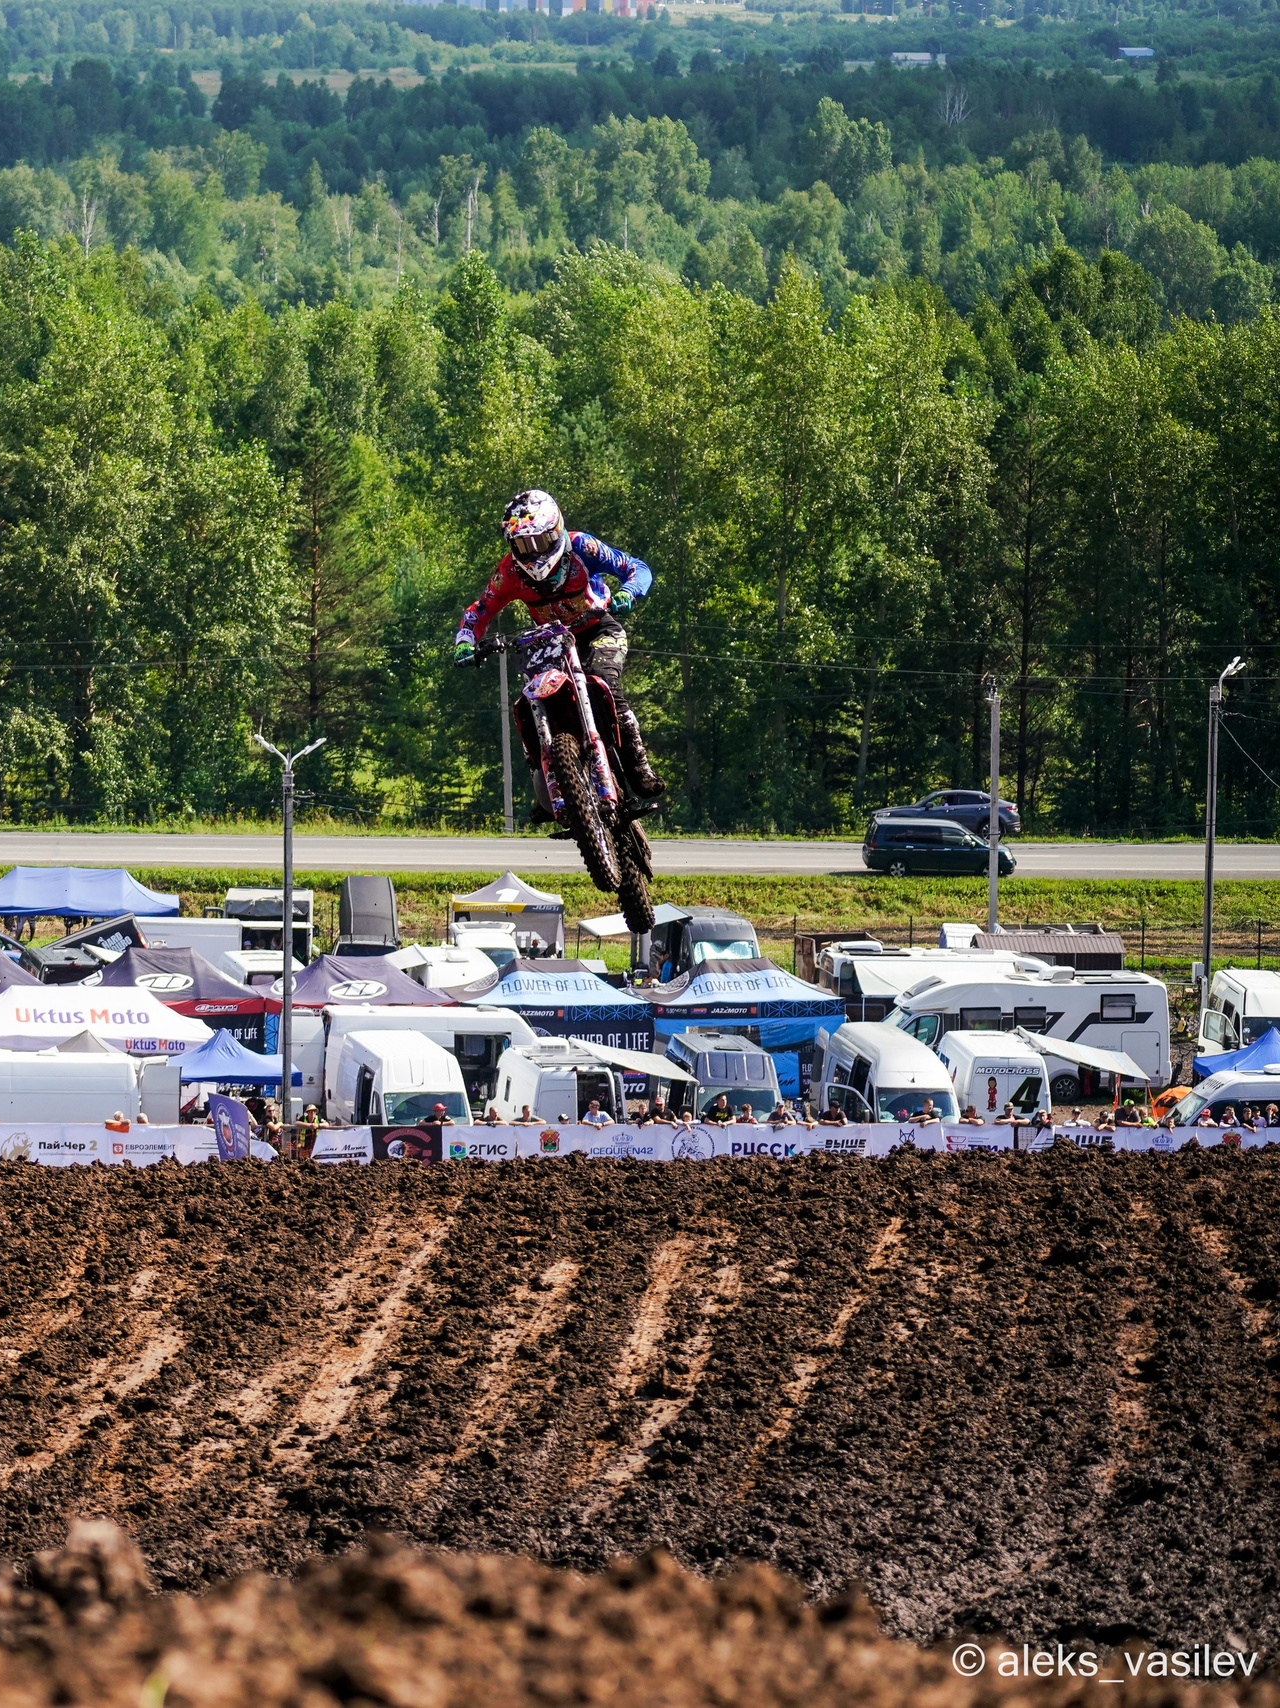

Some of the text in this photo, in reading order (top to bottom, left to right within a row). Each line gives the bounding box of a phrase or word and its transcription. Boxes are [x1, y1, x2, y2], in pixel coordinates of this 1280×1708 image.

[501, 979, 602, 994] FLOWER OF LIFE
[693, 981, 743, 996] FLOWER
[746, 979, 761, 991] OF
[765, 977, 793, 989] LIFE
[15, 1007, 150, 1025] Uktus Moto
[244, 1028, 258, 1040] LIFE
[125, 1038, 185, 1051] Uktus Moto
[608, 1034, 621, 1049] OF
[625, 1033, 649, 1051] LIFE
[975, 1066, 1040, 1075] MOTOCROSS
[1010, 1076, 1043, 1113] 4
[38, 1140, 98, 1152] Пай-Чер 2
[469, 1144, 508, 1155] 2ГИС
[825, 1139, 867, 1149] ВЫШЕ
